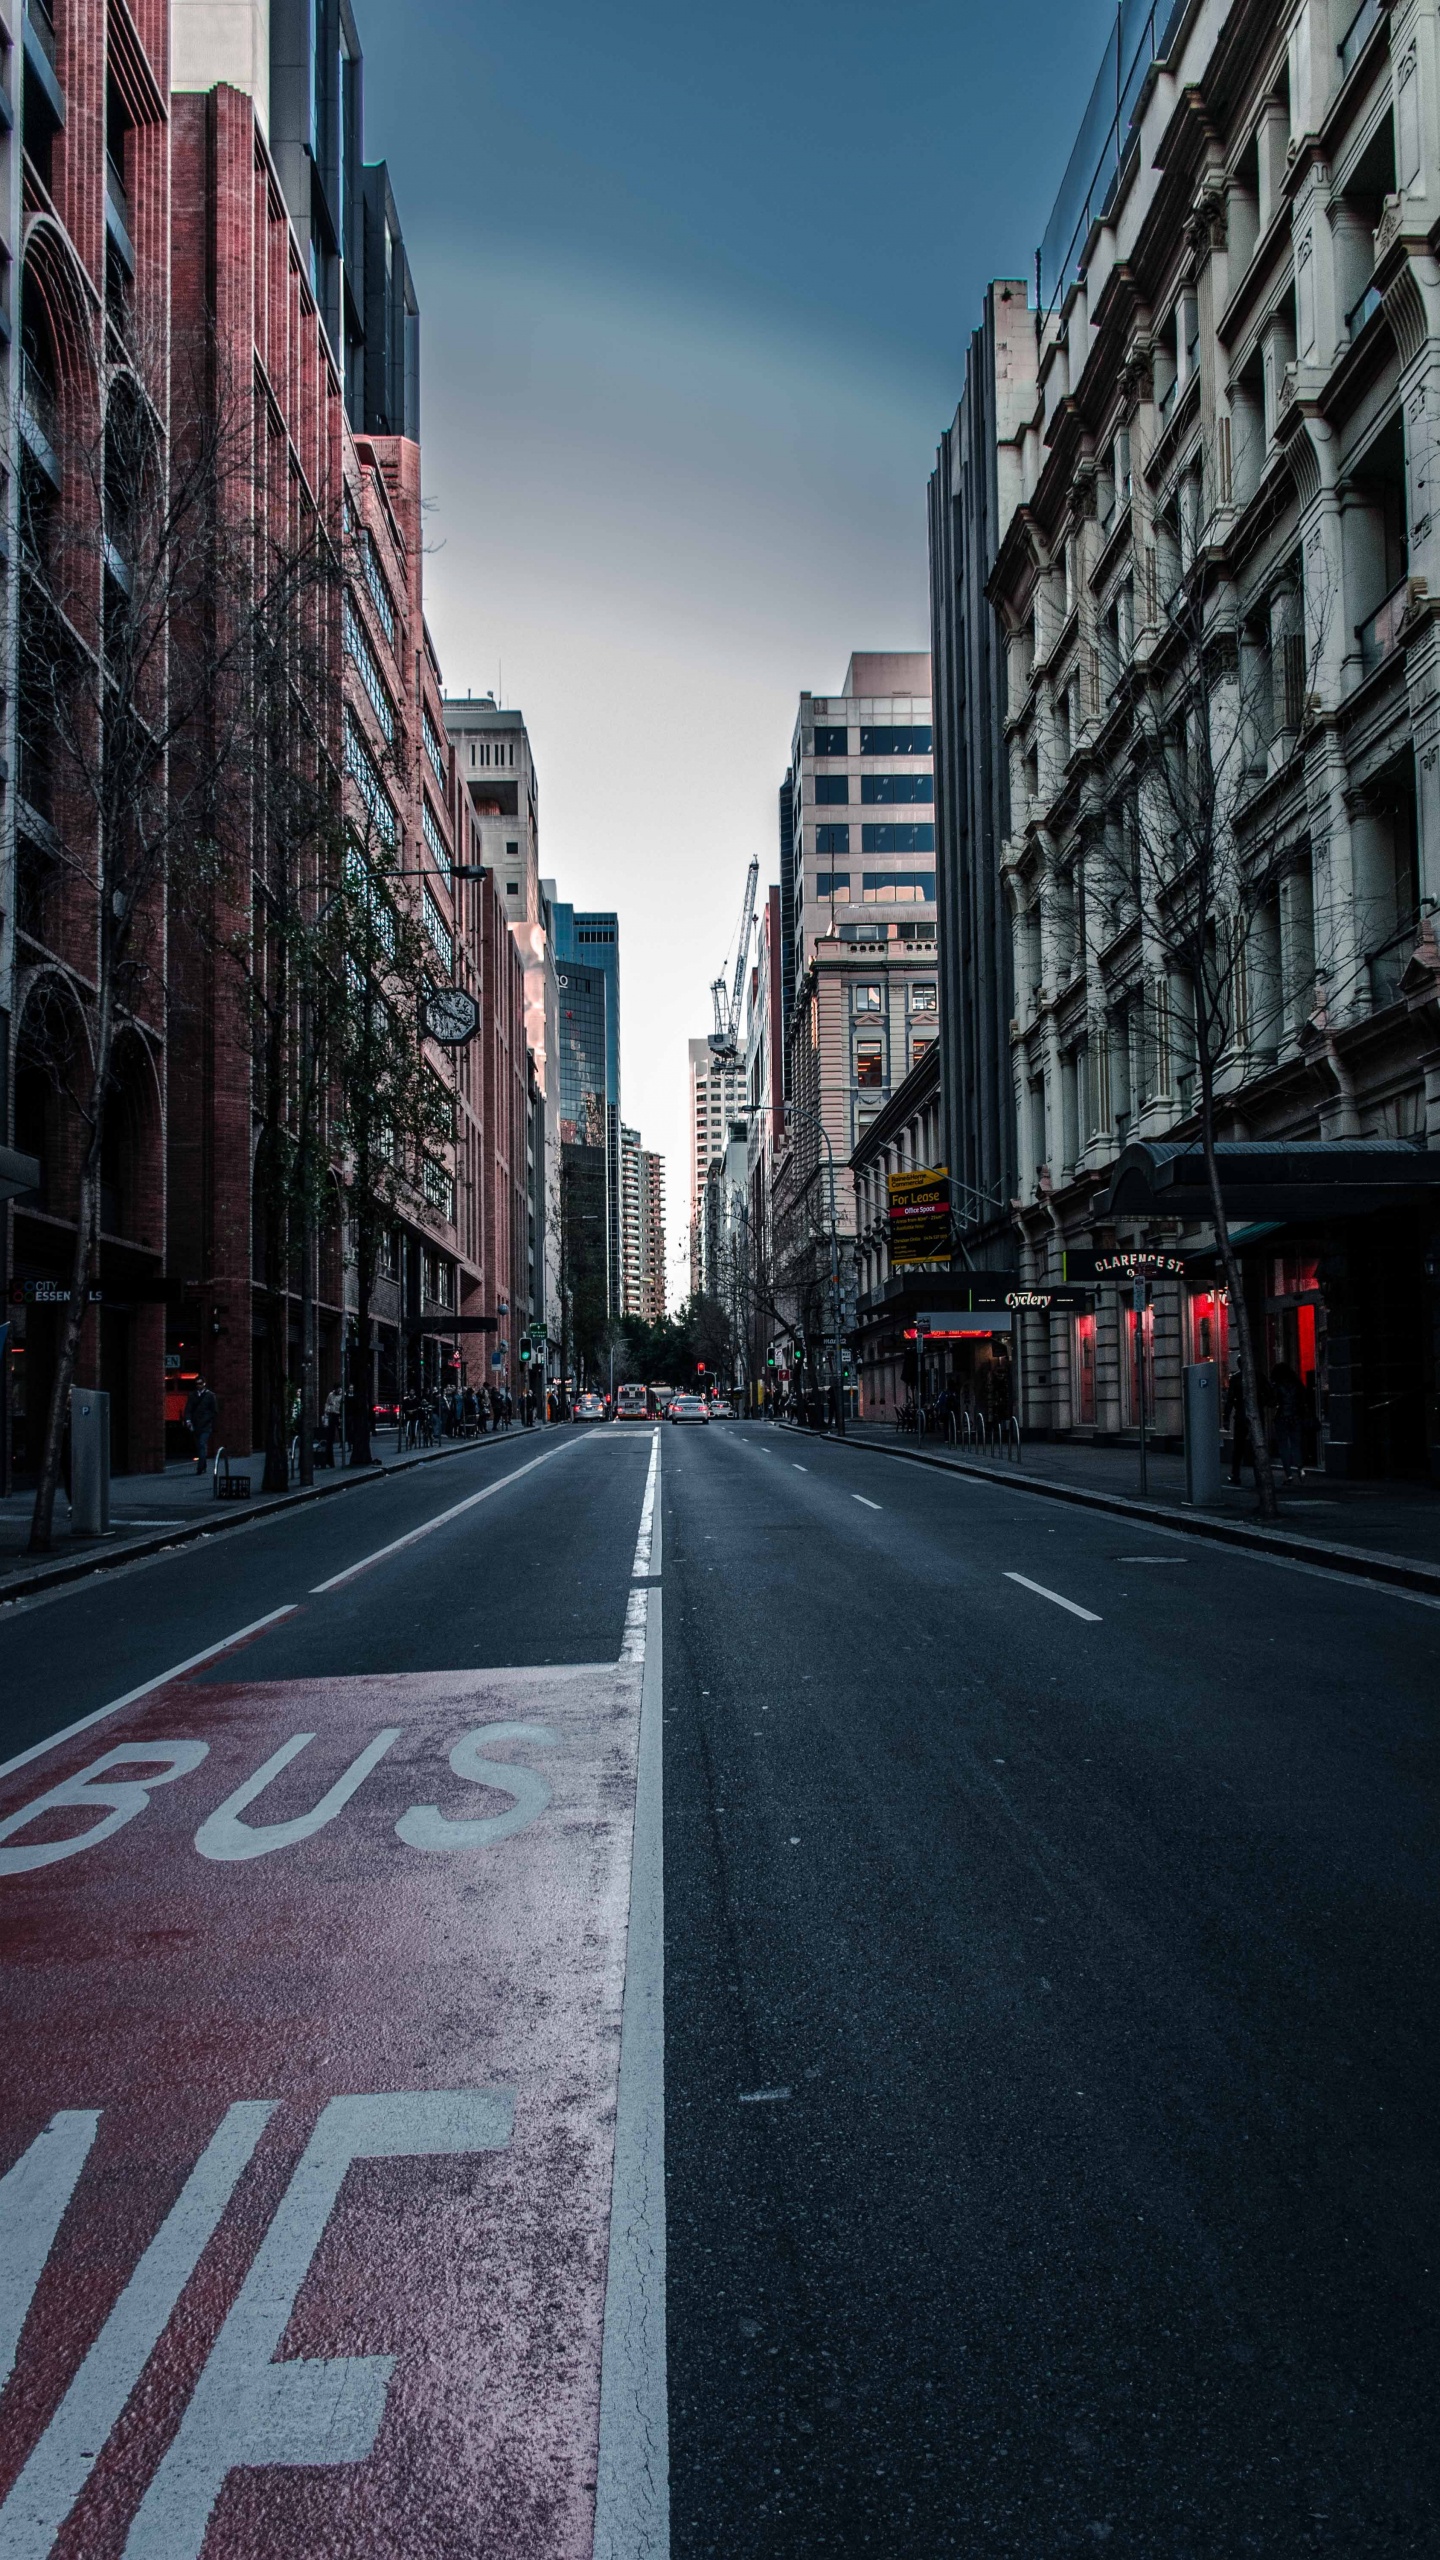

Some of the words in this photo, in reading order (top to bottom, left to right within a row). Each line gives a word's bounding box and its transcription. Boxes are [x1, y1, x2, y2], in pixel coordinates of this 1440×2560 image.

[892, 1195, 909, 1206] For
[911, 1192, 940, 1204] Lease
[920, 1206, 936, 1214] Space
[1095, 1253, 1165, 1272] CLARENCE
[1167, 1259, 1185, 1275] ST.
[36, 1281, 59, 1291] CITY
[35, 1291, 103, 1301] ESSENLS
[1005, 1292, 1051, 1309] Cyclery
[1200, 1379, 1207, 1388] P
[82, 1406, 89, 1415] P
[0, 1721, 561, 1876] BUS
